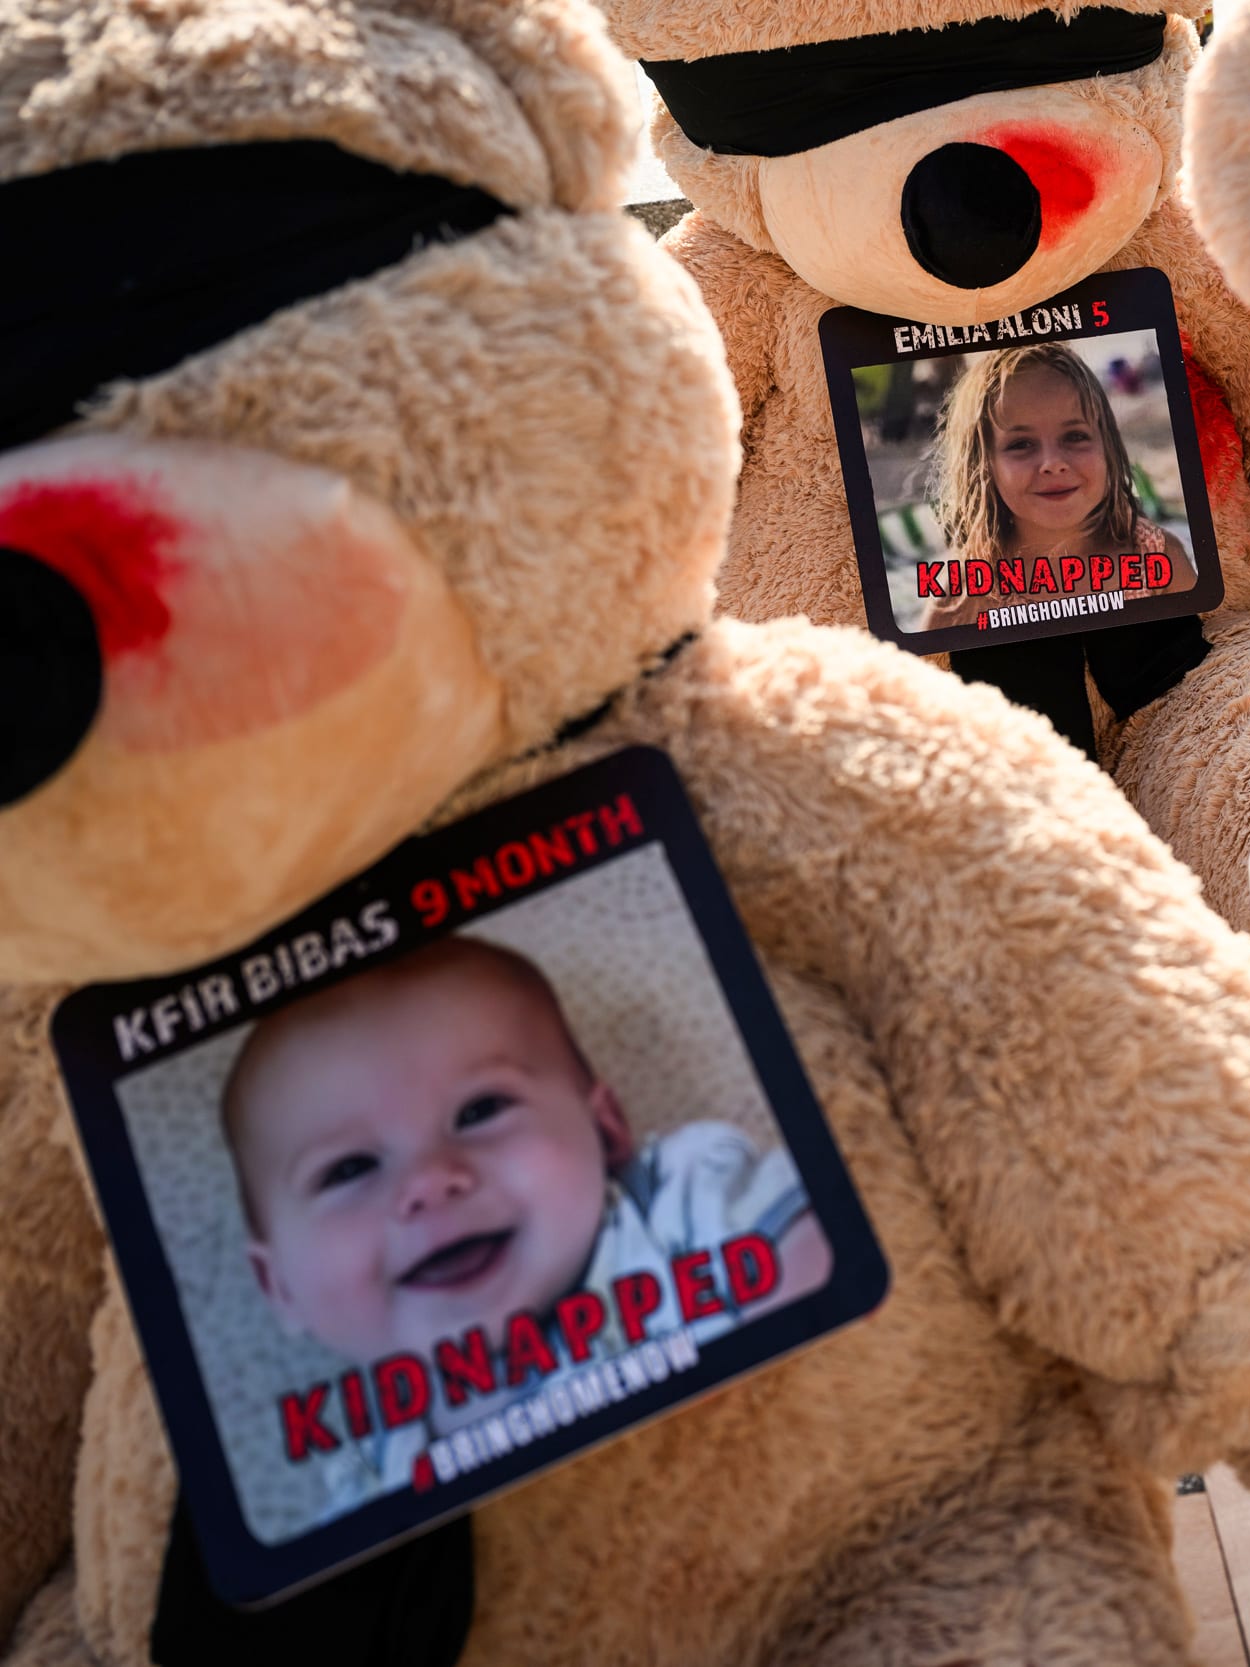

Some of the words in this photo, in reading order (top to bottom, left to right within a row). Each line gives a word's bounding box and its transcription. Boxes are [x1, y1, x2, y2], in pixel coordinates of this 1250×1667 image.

[893, 324, 992, 354] EMILIA
[996, 303, 1083, 341] ALONI
[1091, 301, 1110, 328] 5
[916, 552, 1173, 598] KIDNAPPED
[977, 590, 1125, 631] #BRINGHOMENOW
[112, 975, 239, 1063] KFIR
[242, 900, 399, 1004] BIBAS
[410, 879, 451, 928] 9
[450, 793, 645, 909] MONTH
[278, 1232, 782, 1463] KIDNAPPED
